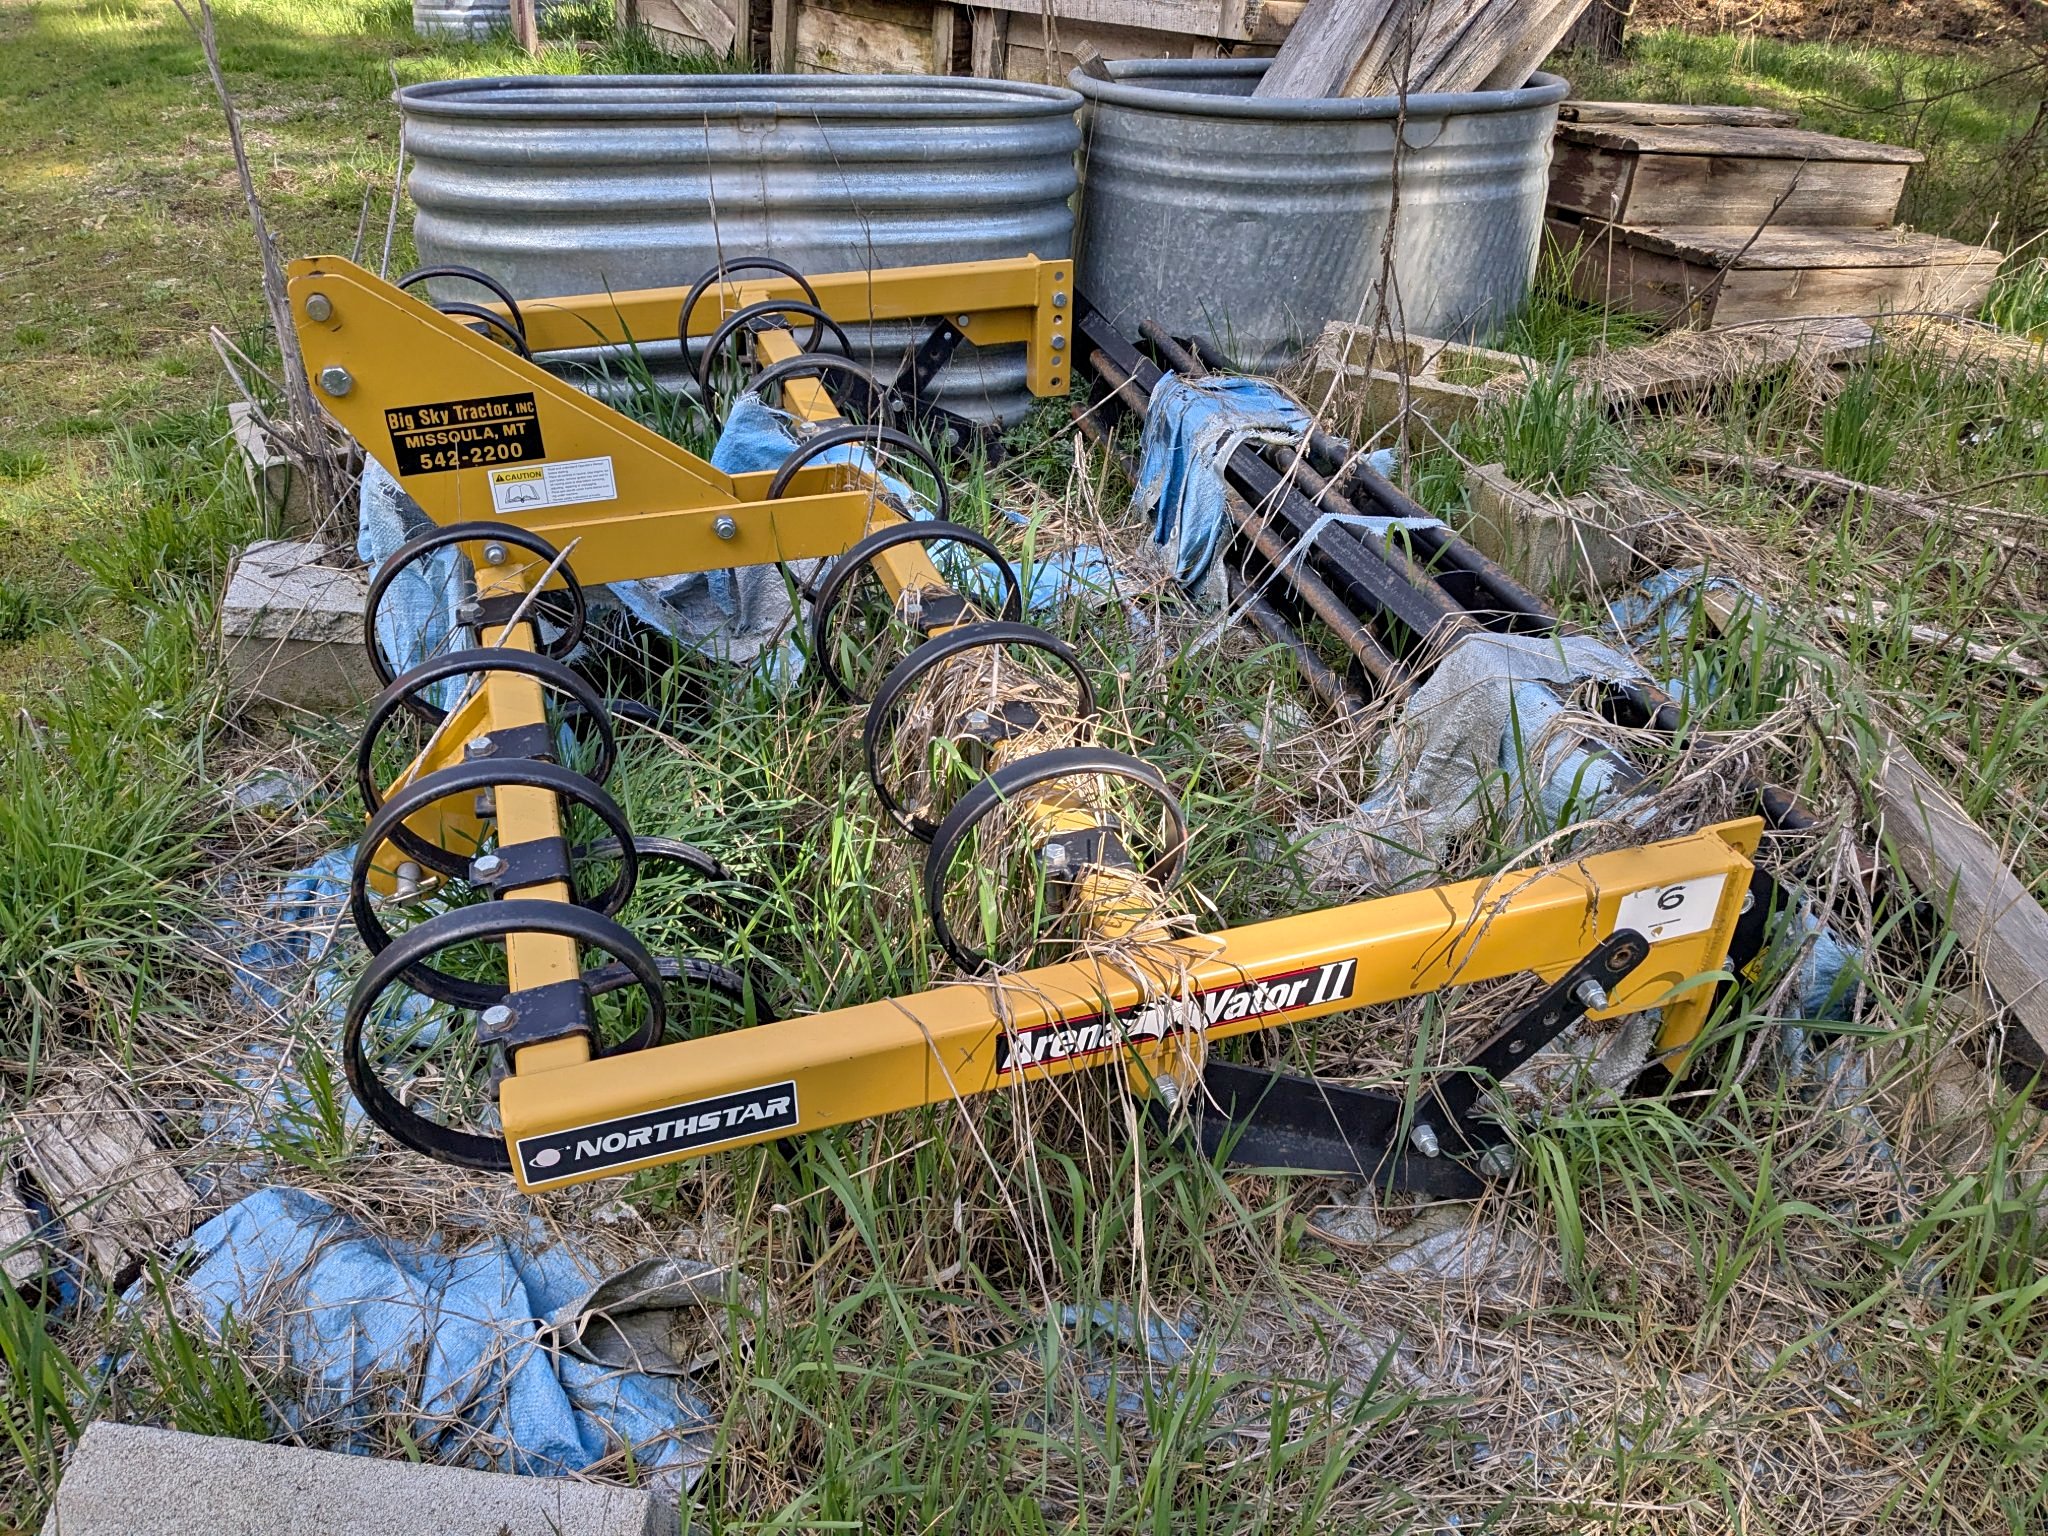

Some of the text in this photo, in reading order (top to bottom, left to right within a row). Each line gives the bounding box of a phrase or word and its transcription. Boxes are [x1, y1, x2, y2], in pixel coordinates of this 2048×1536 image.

[387, 401, 535, 430] Big Sky Tractor, INC
[405, 423, 527, 449] MISSOULA, MT
[420, 443, 523, 470] 542-2200
[505, 471, 542, 482] CAUTION
[1657, 885, 1686, 911] 6
[1203, 978, 1311, 1025] Vator
[1307, 958, 1357, 1006] II
[574, 1096, 791, 1161] NORTHSTAR
